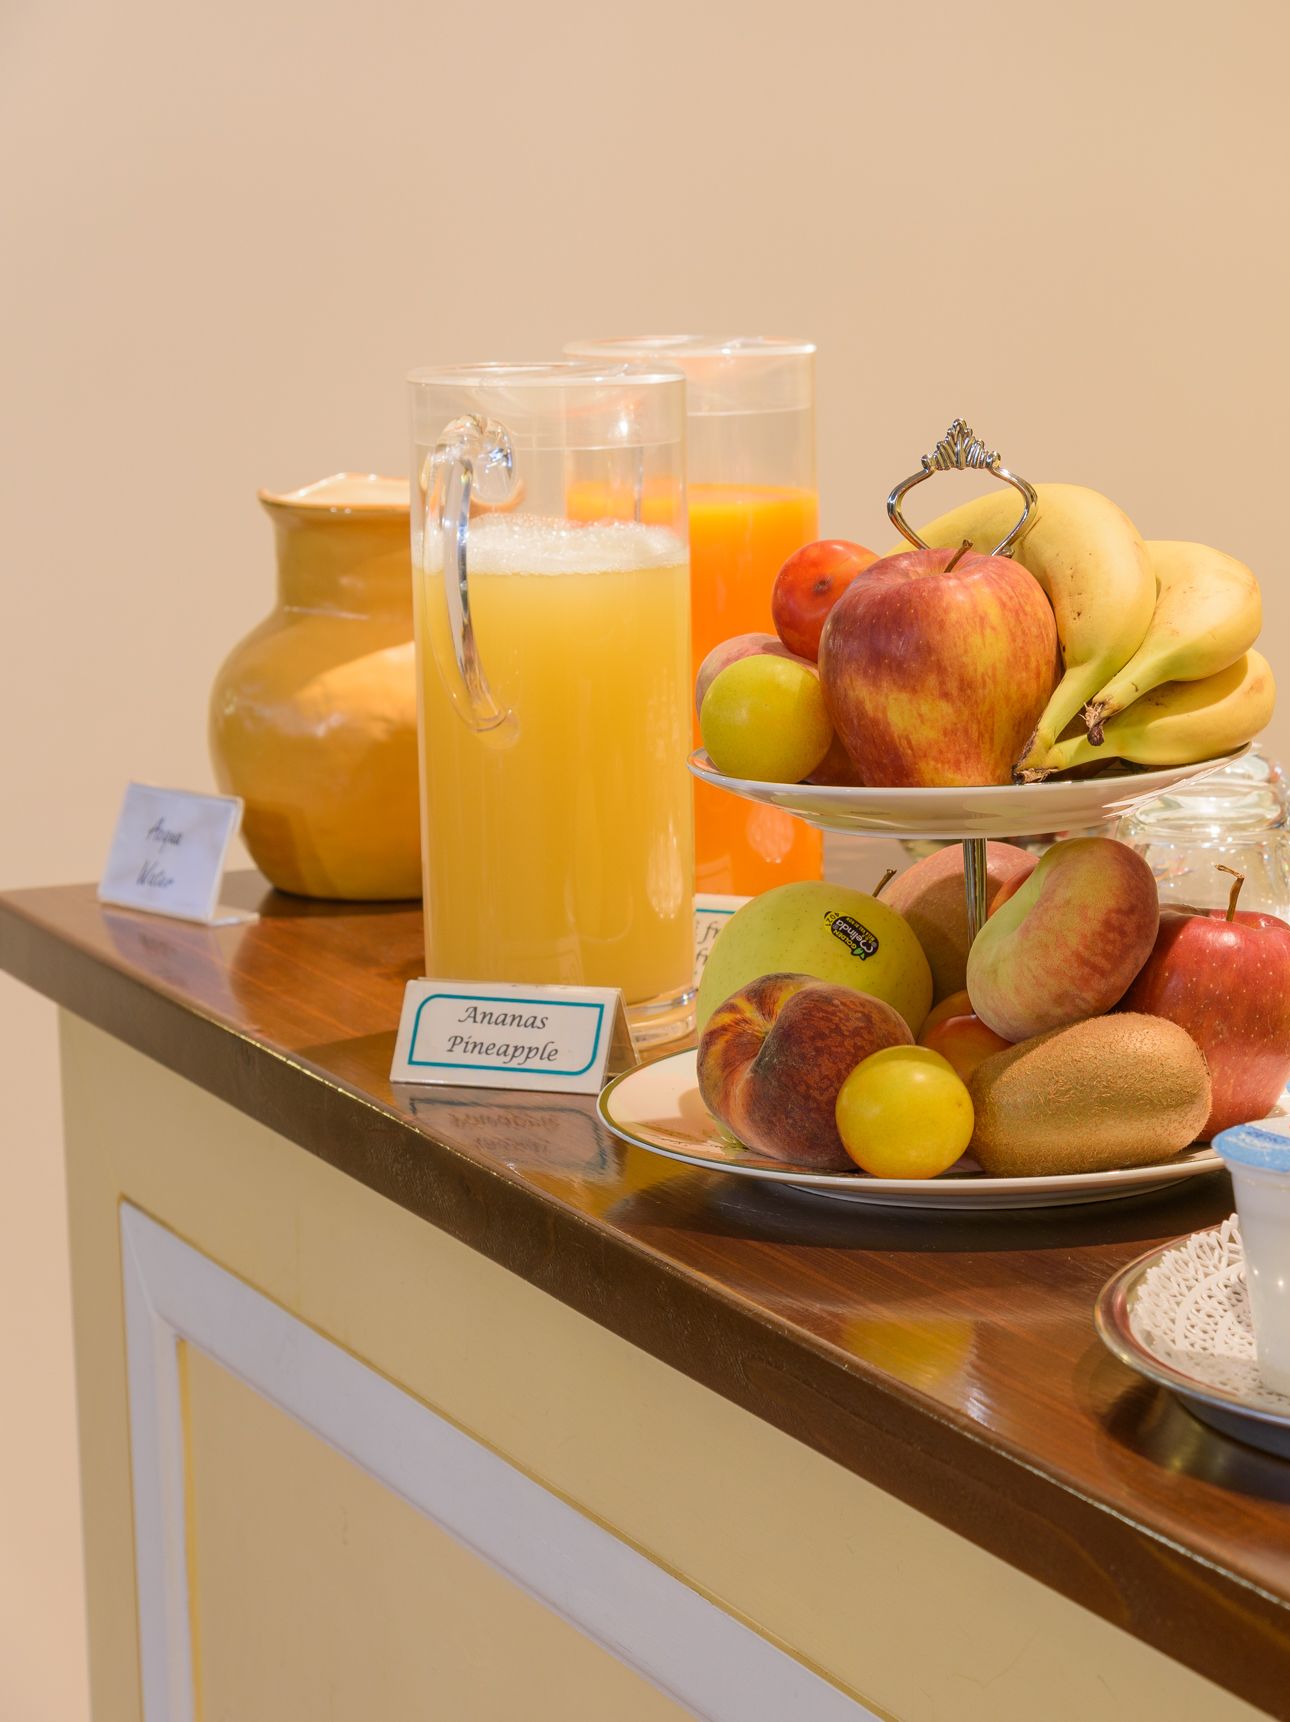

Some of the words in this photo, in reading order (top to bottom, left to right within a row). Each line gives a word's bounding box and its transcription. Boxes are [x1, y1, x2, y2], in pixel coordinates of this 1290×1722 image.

[836, 919, 874, 953] Melinda
[458, 1006, 549, 1030] Ananas
[446, 1035, 559, 1066] Pineapple
